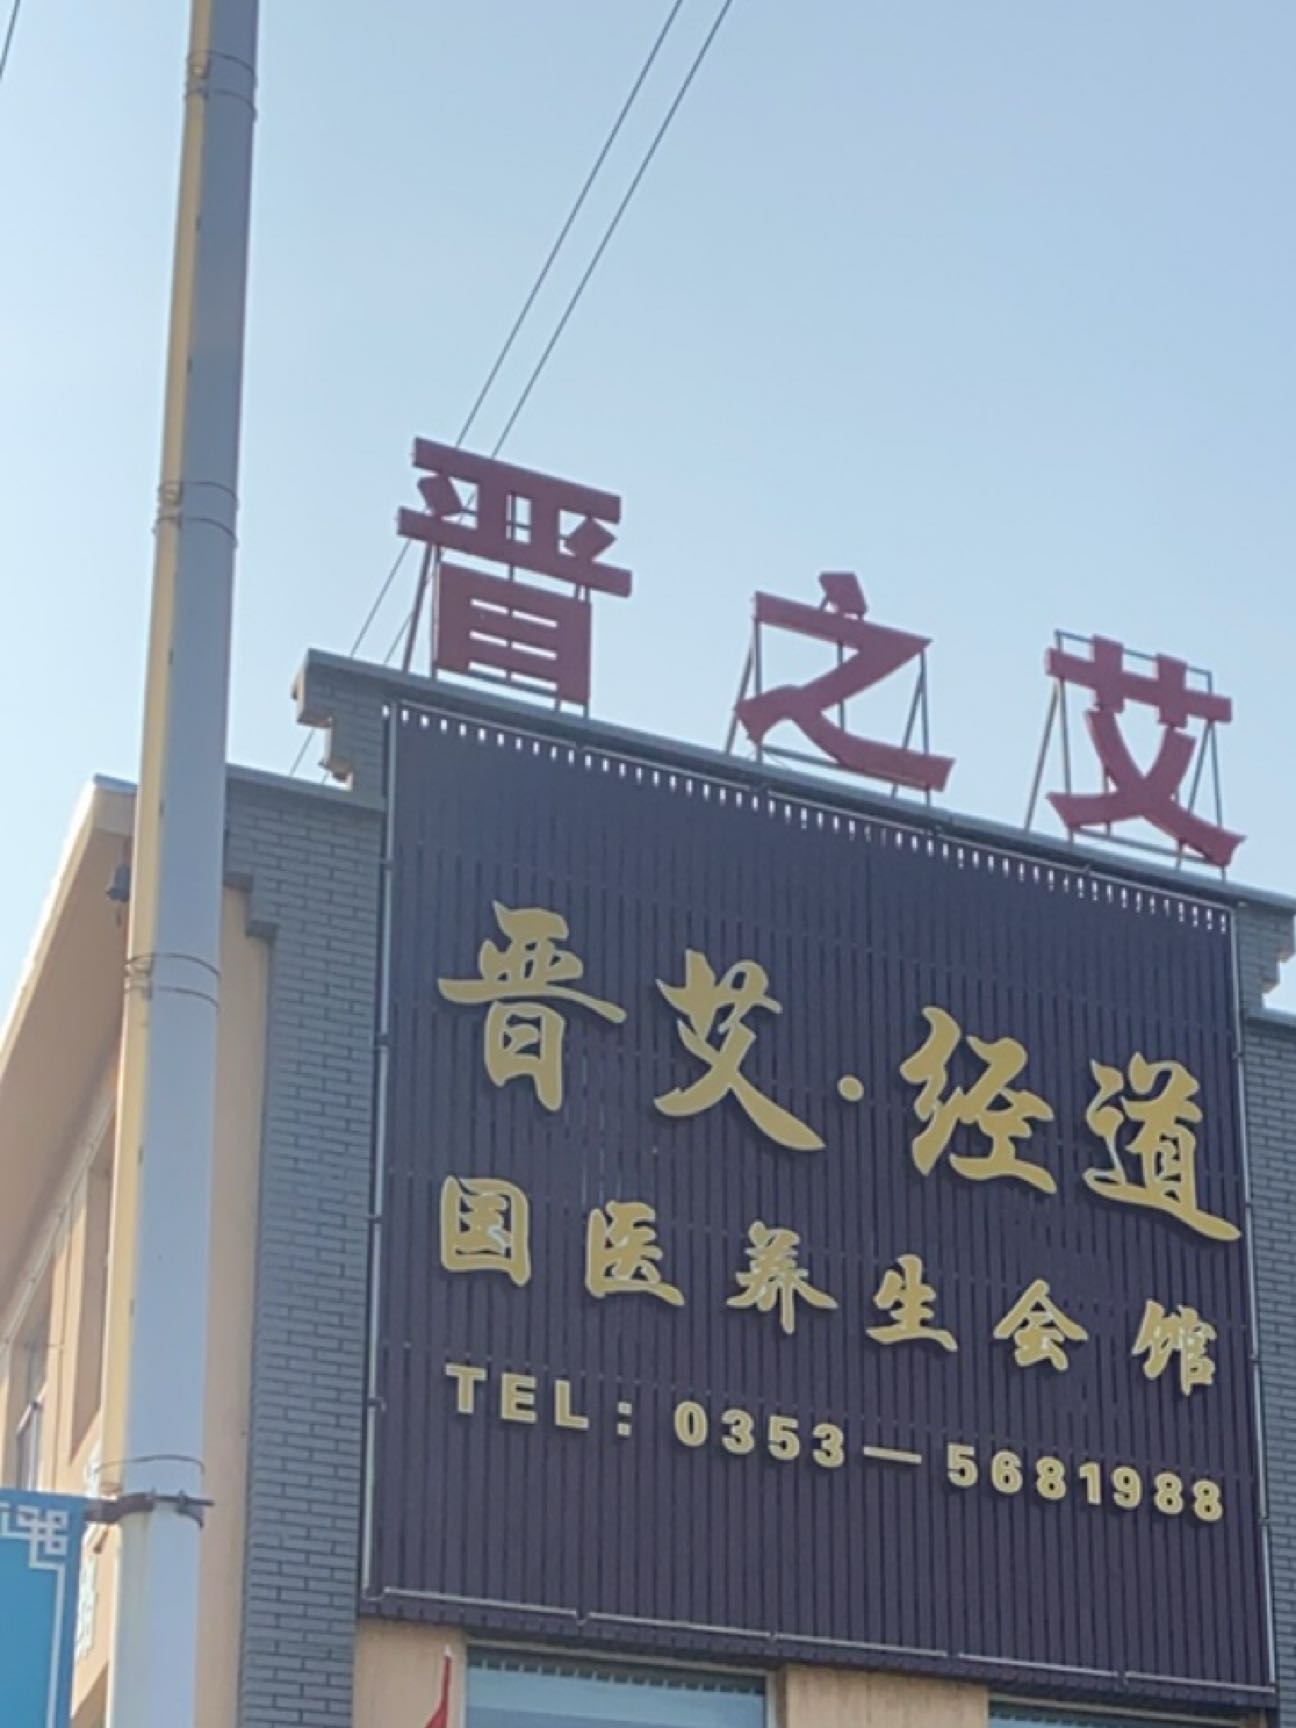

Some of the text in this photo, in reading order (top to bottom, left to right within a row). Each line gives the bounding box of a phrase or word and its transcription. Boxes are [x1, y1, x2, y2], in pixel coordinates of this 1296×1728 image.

[398, 437, 1246, 866] 晋之艾
[439, 1175, 1217, 1396] 国医养生会馆
